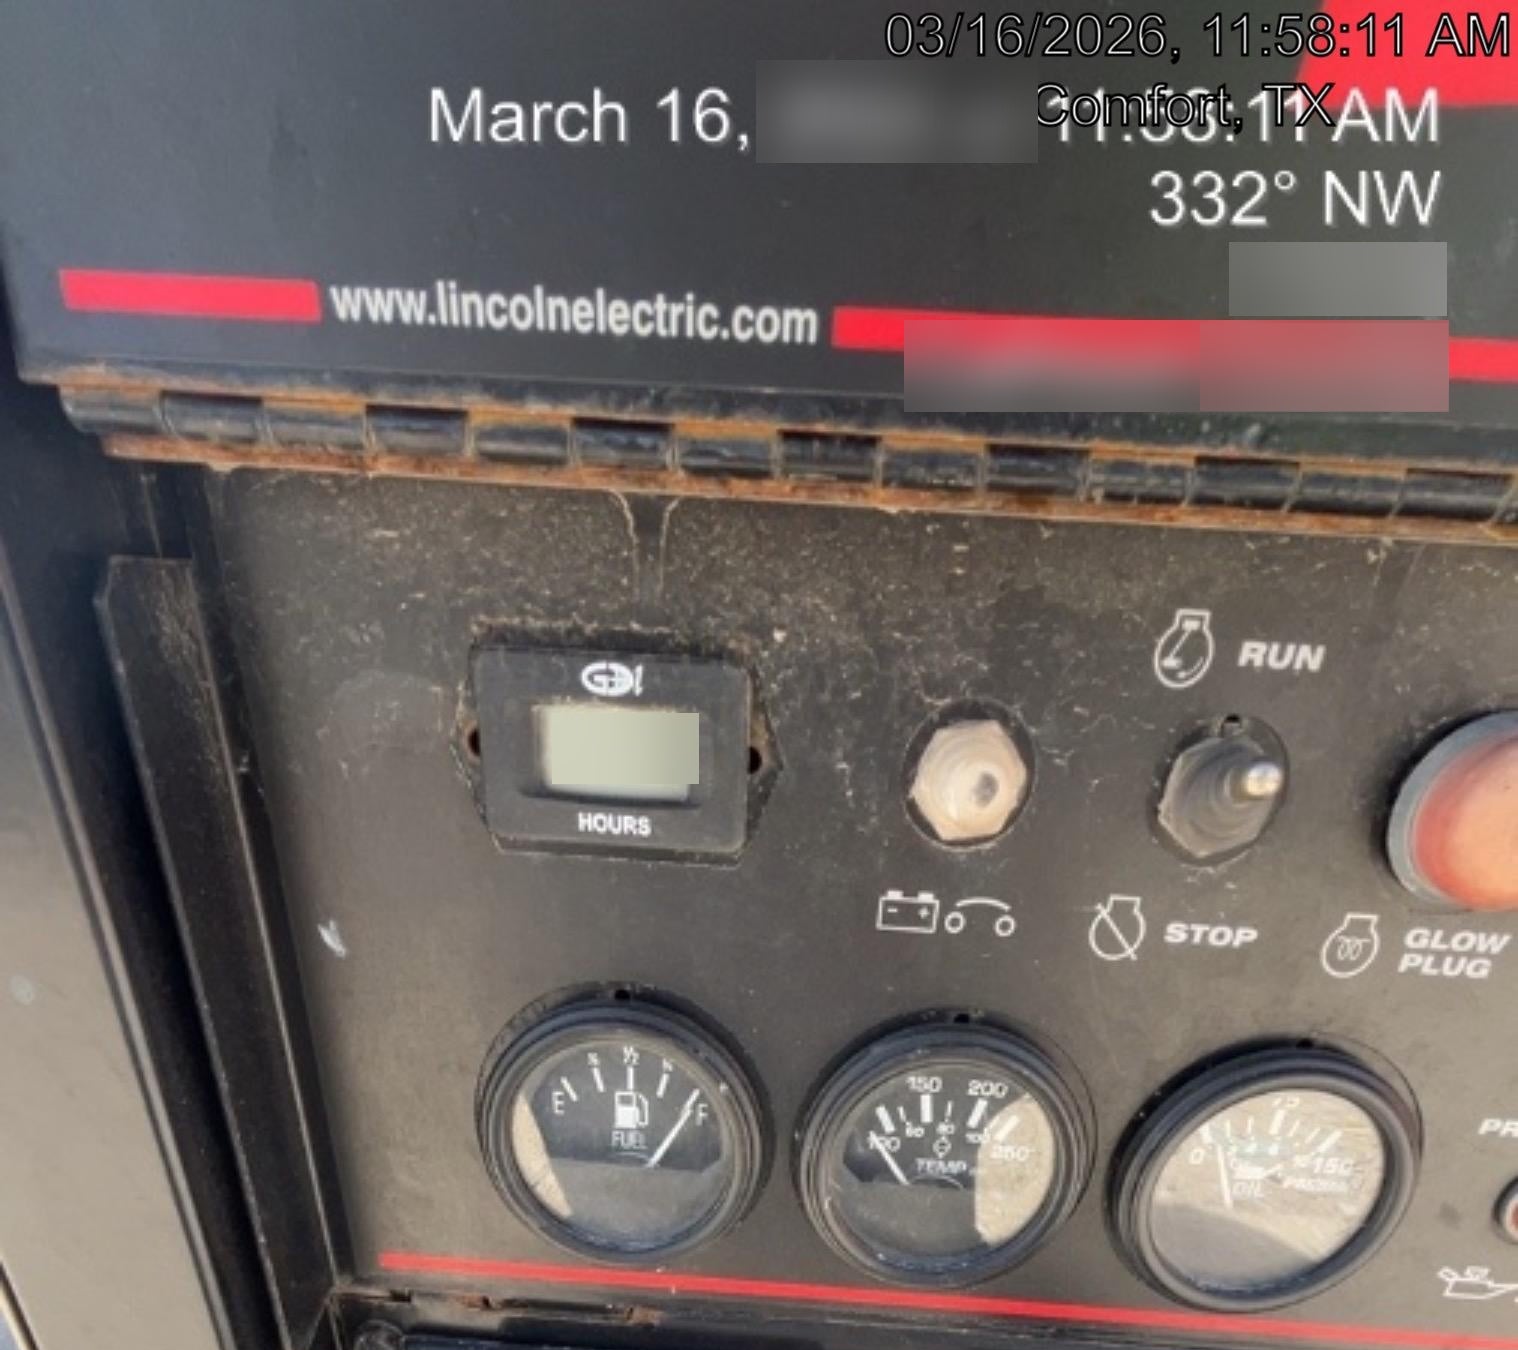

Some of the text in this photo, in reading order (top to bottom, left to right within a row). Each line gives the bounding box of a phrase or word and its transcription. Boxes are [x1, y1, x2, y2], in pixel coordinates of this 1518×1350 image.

[330, 280, 819, 345] www.lincolnelectric.com
[1238, 641, 1326, 672] RUN
[577, 811, 652, 838] HOURS
[1164, 922, 1259, 949] STOP
[1403, 928, 1513, 955] GLOW
[1398, 953, 1492, 979] PLUG
[906, 1076, 942, 1093] 150
[967, 1079, 1009, 1098] 200
[551, 1091, 565, 1115] E
[695, 1102, 709, 1126] F
[611, 1130, 647, 1150] FUEL
[915, 1157, 968, 1174] TEMP
